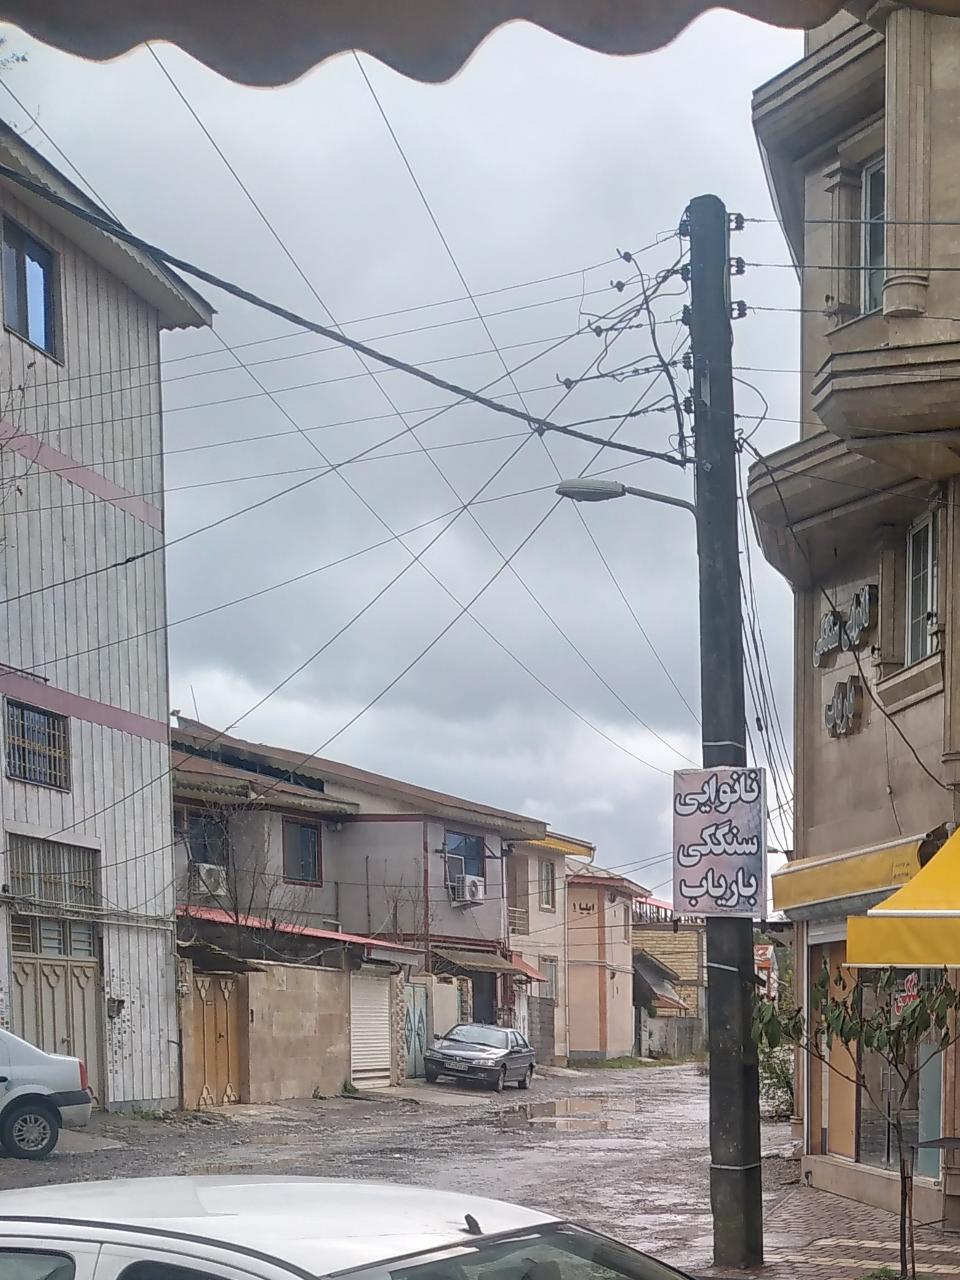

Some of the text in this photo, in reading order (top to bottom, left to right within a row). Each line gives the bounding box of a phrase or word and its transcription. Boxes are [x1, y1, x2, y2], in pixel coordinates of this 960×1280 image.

[674, 770, 761, 816] نانوایی
[677, 819, 760, 868] سنگکی
[679, 866, 759, 908] باریاب
